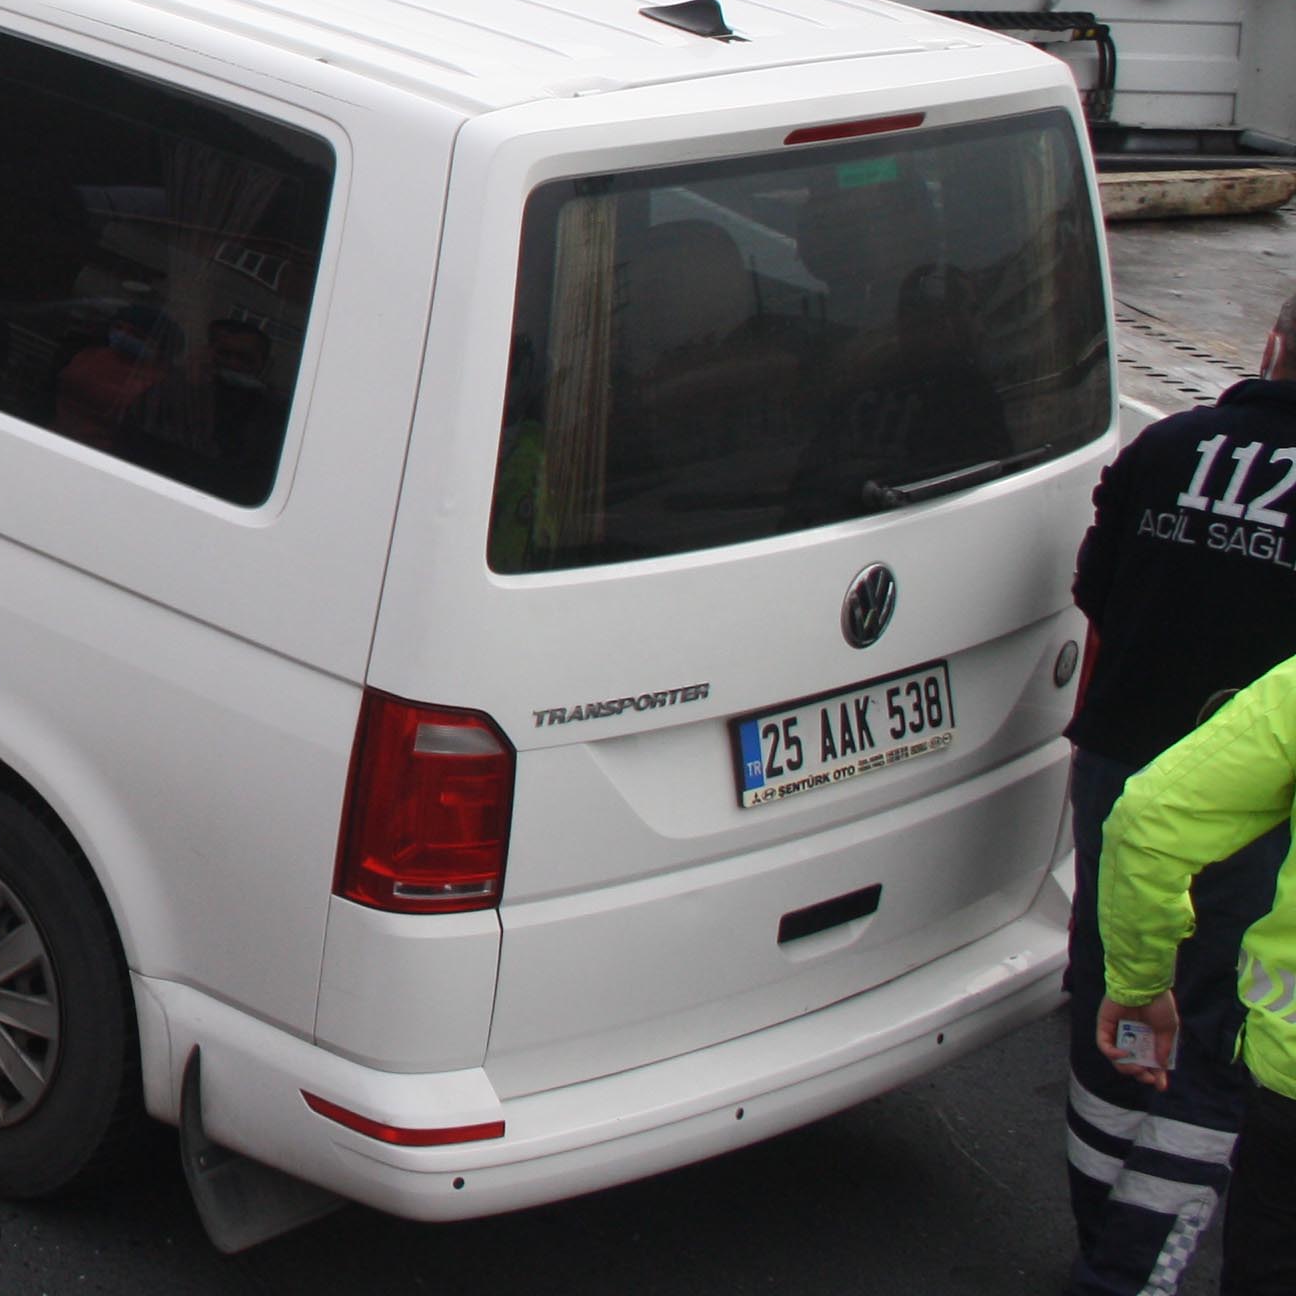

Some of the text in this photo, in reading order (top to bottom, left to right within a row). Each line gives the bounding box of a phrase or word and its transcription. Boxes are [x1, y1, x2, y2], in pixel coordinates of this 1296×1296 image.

[1176, 434, 1296, 528] 112
[1207, 522, 1296, 572] SAĞL
[533, 683, 710, 728] TRANSPORTER
[762, 676, 943, 779] 25 AAK 538
[747, 760, 764, 777] TR
[778, 765, 856, 797] ŞENTÜRK OTO
